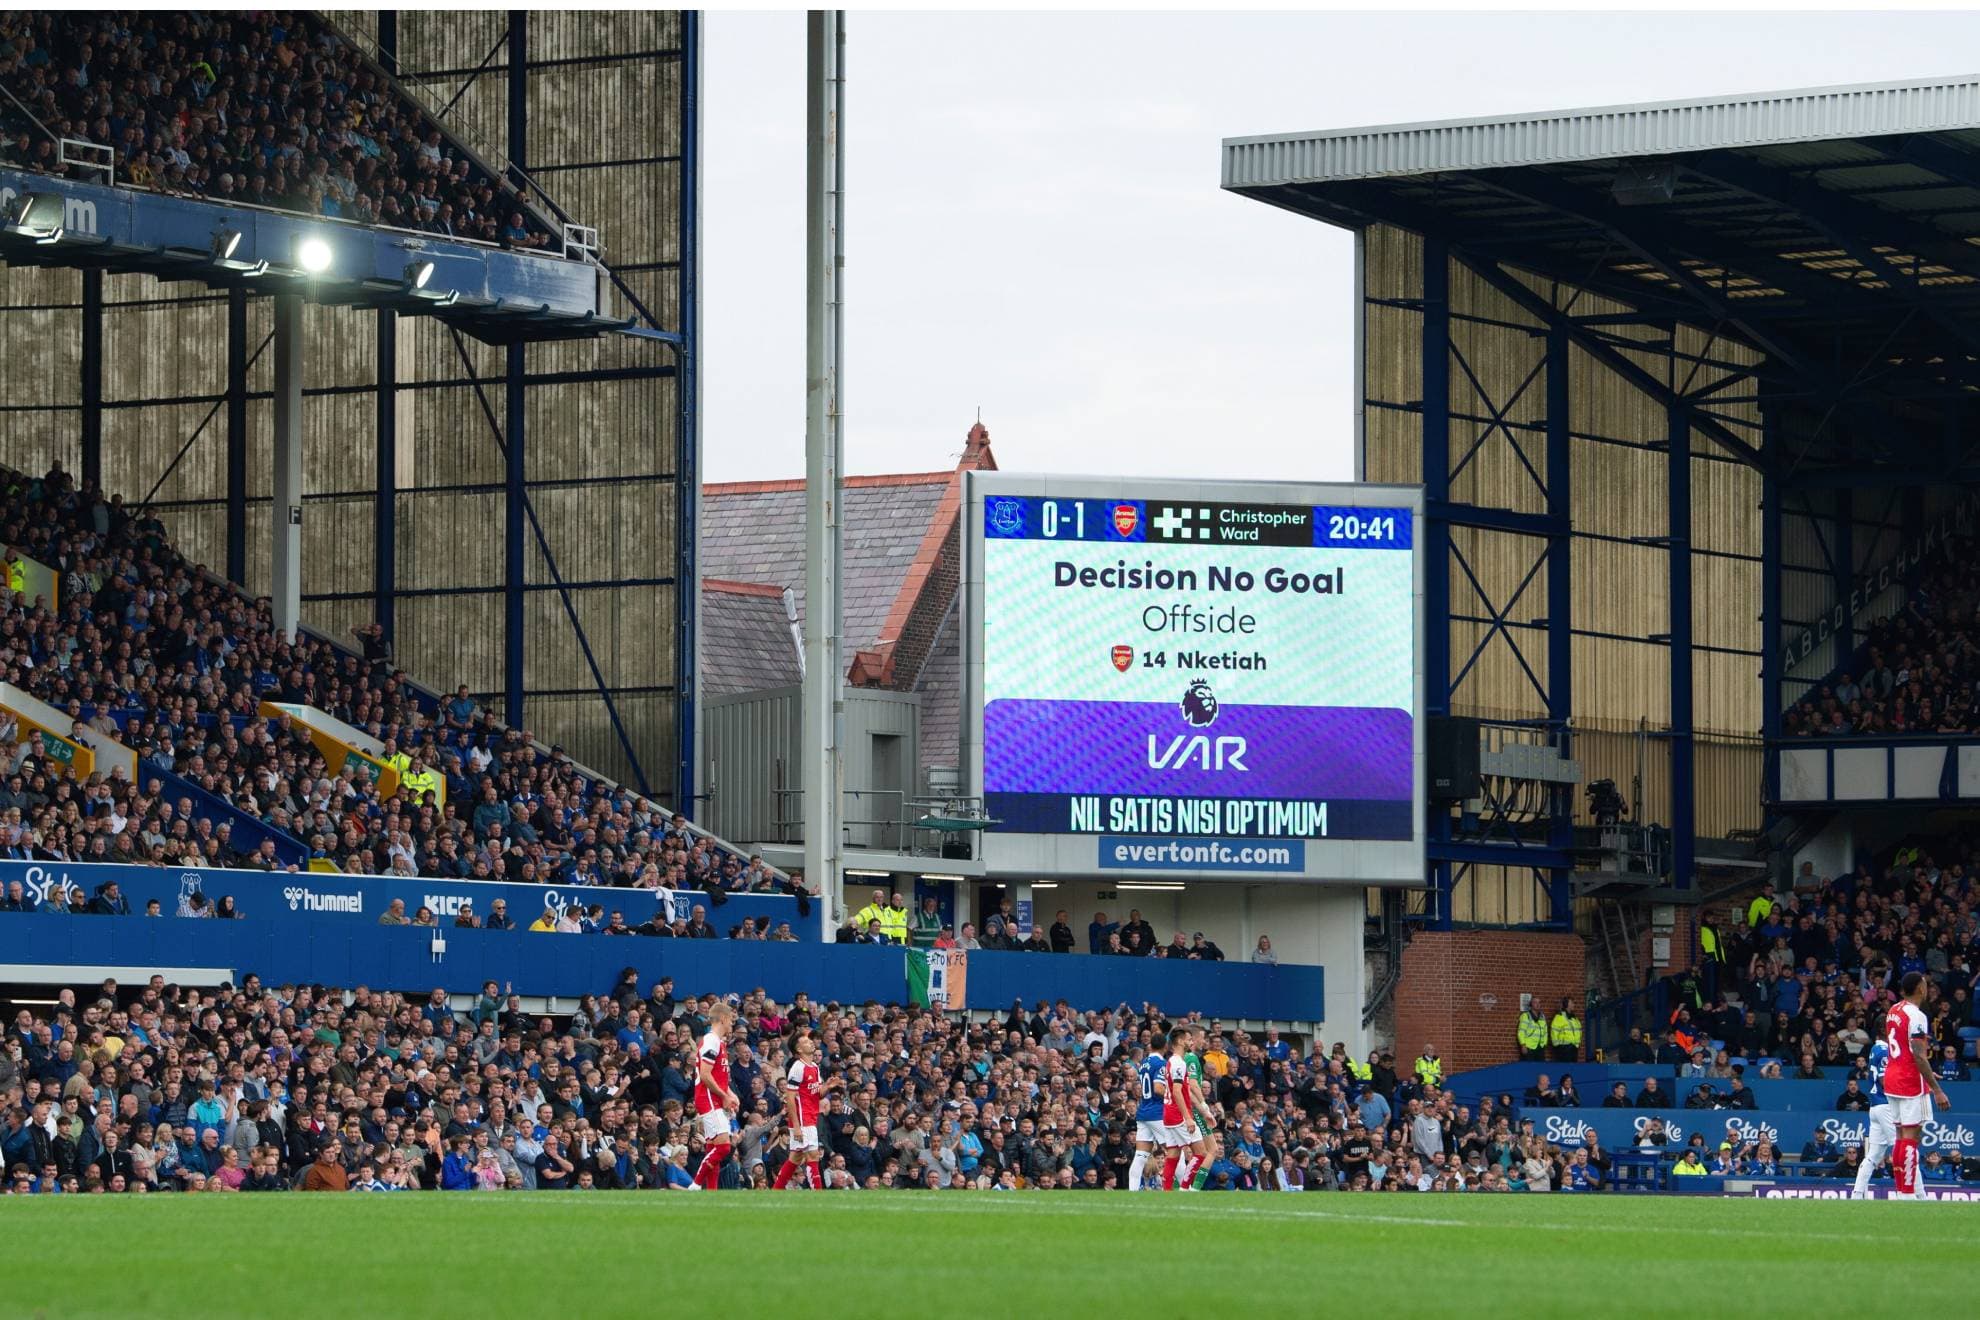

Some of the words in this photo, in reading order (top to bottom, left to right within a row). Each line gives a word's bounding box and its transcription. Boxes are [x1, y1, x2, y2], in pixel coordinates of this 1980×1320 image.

[1042, 501, 1084, 538] 0-1
[1219, 509, 1307, 528] Christopher
[1329, 515, 1394, 540] 20:41
[1219, 527, 1259, 541] Ward
[1055, 560, 1197, 591] Decision
[1208, 566, 1255, 592] No
[1264, 567, 1344, 595] Goal
[1143, 604, 1256, 634] Offside
[1143, 651, 1167, 668] 14
[1177, 651, 1267, 671] Nketiah
[1148, 734, 1249, 771] VAR
[1071, 797, 1104, 831] NIL
[1110, 797, 1172, 833] SATIS
[1178, 799, 1220, 834] NISI
[1226, 801, 1327, 836] OPTIMUM
[1115, 842, 1289, 864] evertonfc.com
[26, 866, 79, 906] Stk
[304, 888, 362, 912] hummel
[1634, 1116, 1682, 1142] Ske
[1823, 1119, 1866, 1144] Stak
[1921, 1120, 1975, 1147] Stake
